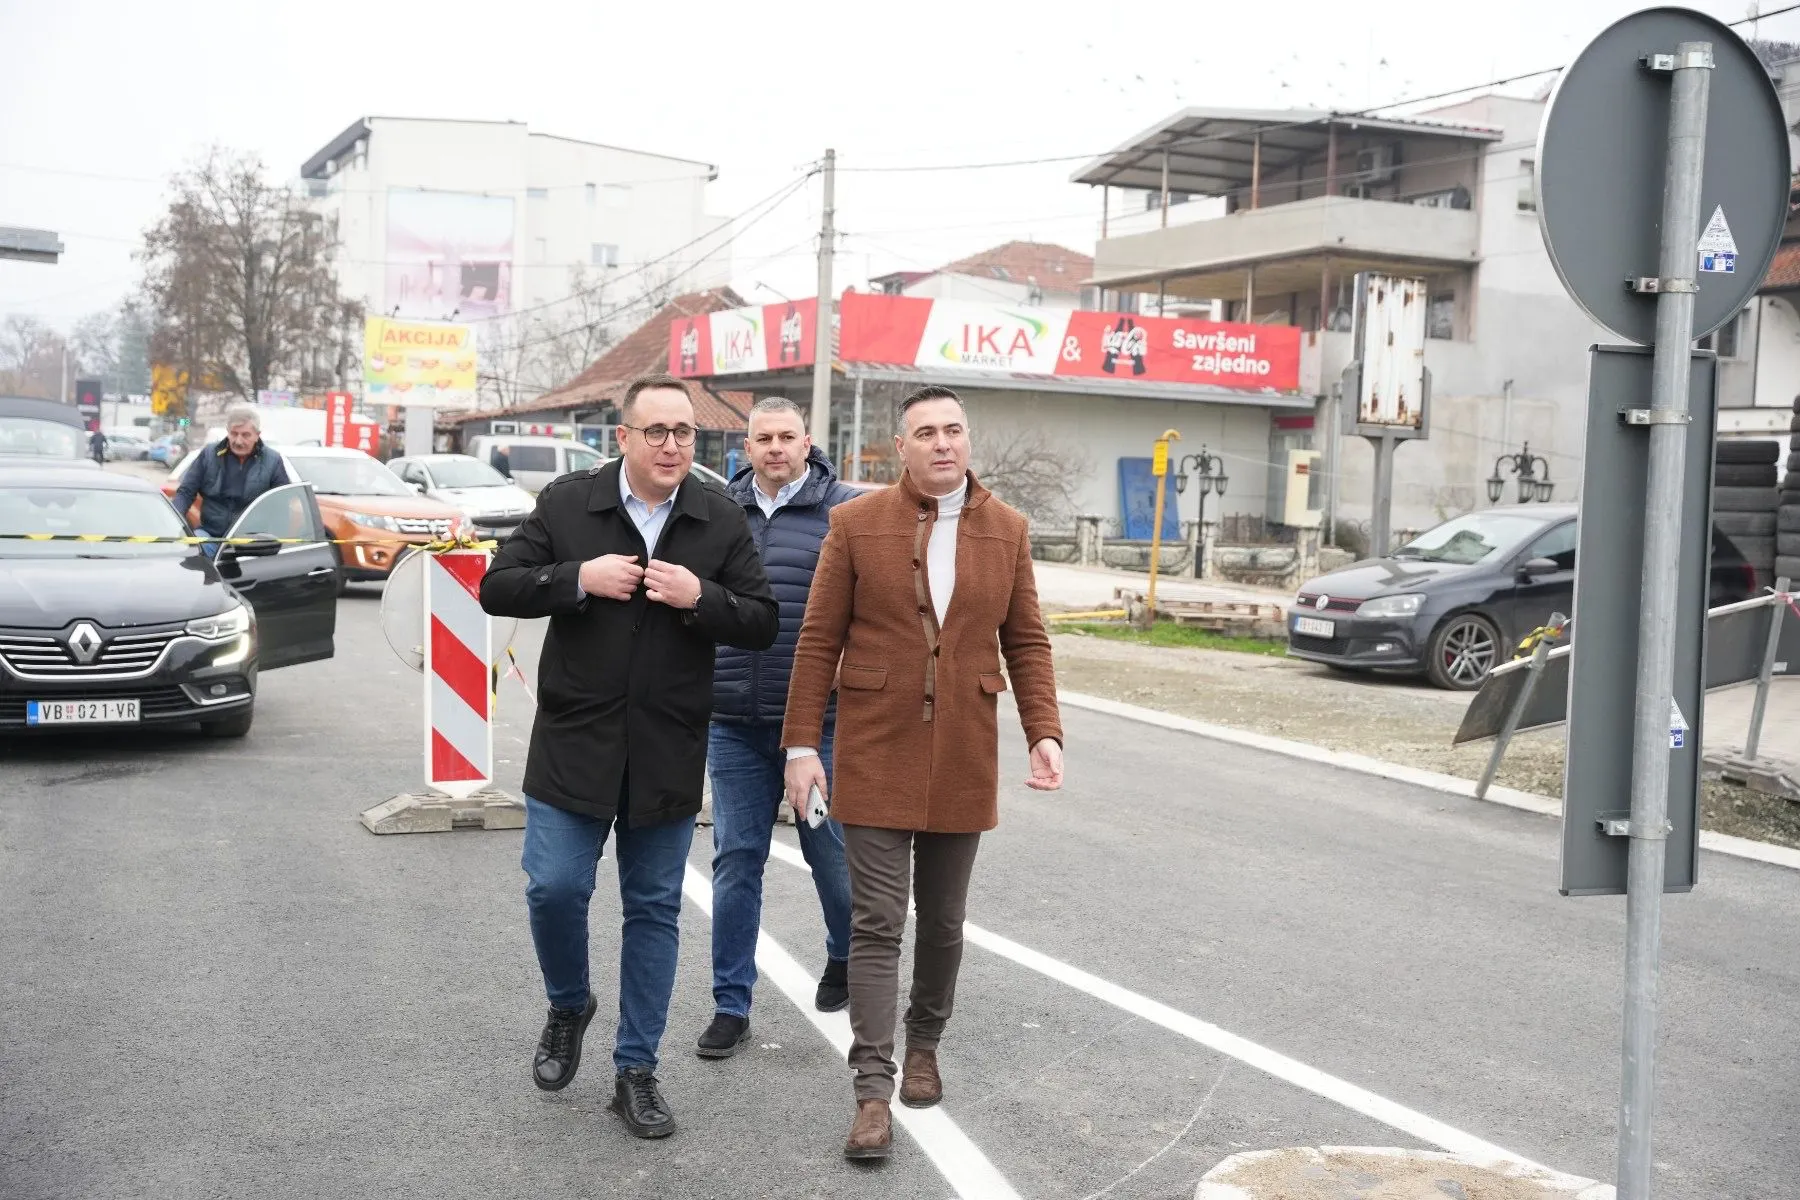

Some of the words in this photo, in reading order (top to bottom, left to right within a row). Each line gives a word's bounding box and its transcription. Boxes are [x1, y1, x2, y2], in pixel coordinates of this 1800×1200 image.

[384, 328, 459, 347] AKCIJA
[724, 329, 754, 361] IKA
[962, 323, 1035, 358] IKA
[1062, 335, 1082, 362] &
[1173, 328, 1256, 354] Savršeni
[960, 352, 1013, 368] MARKET
[1192, 353, 1271, 376] zajedno
[42, 704, 62, 720] VB
